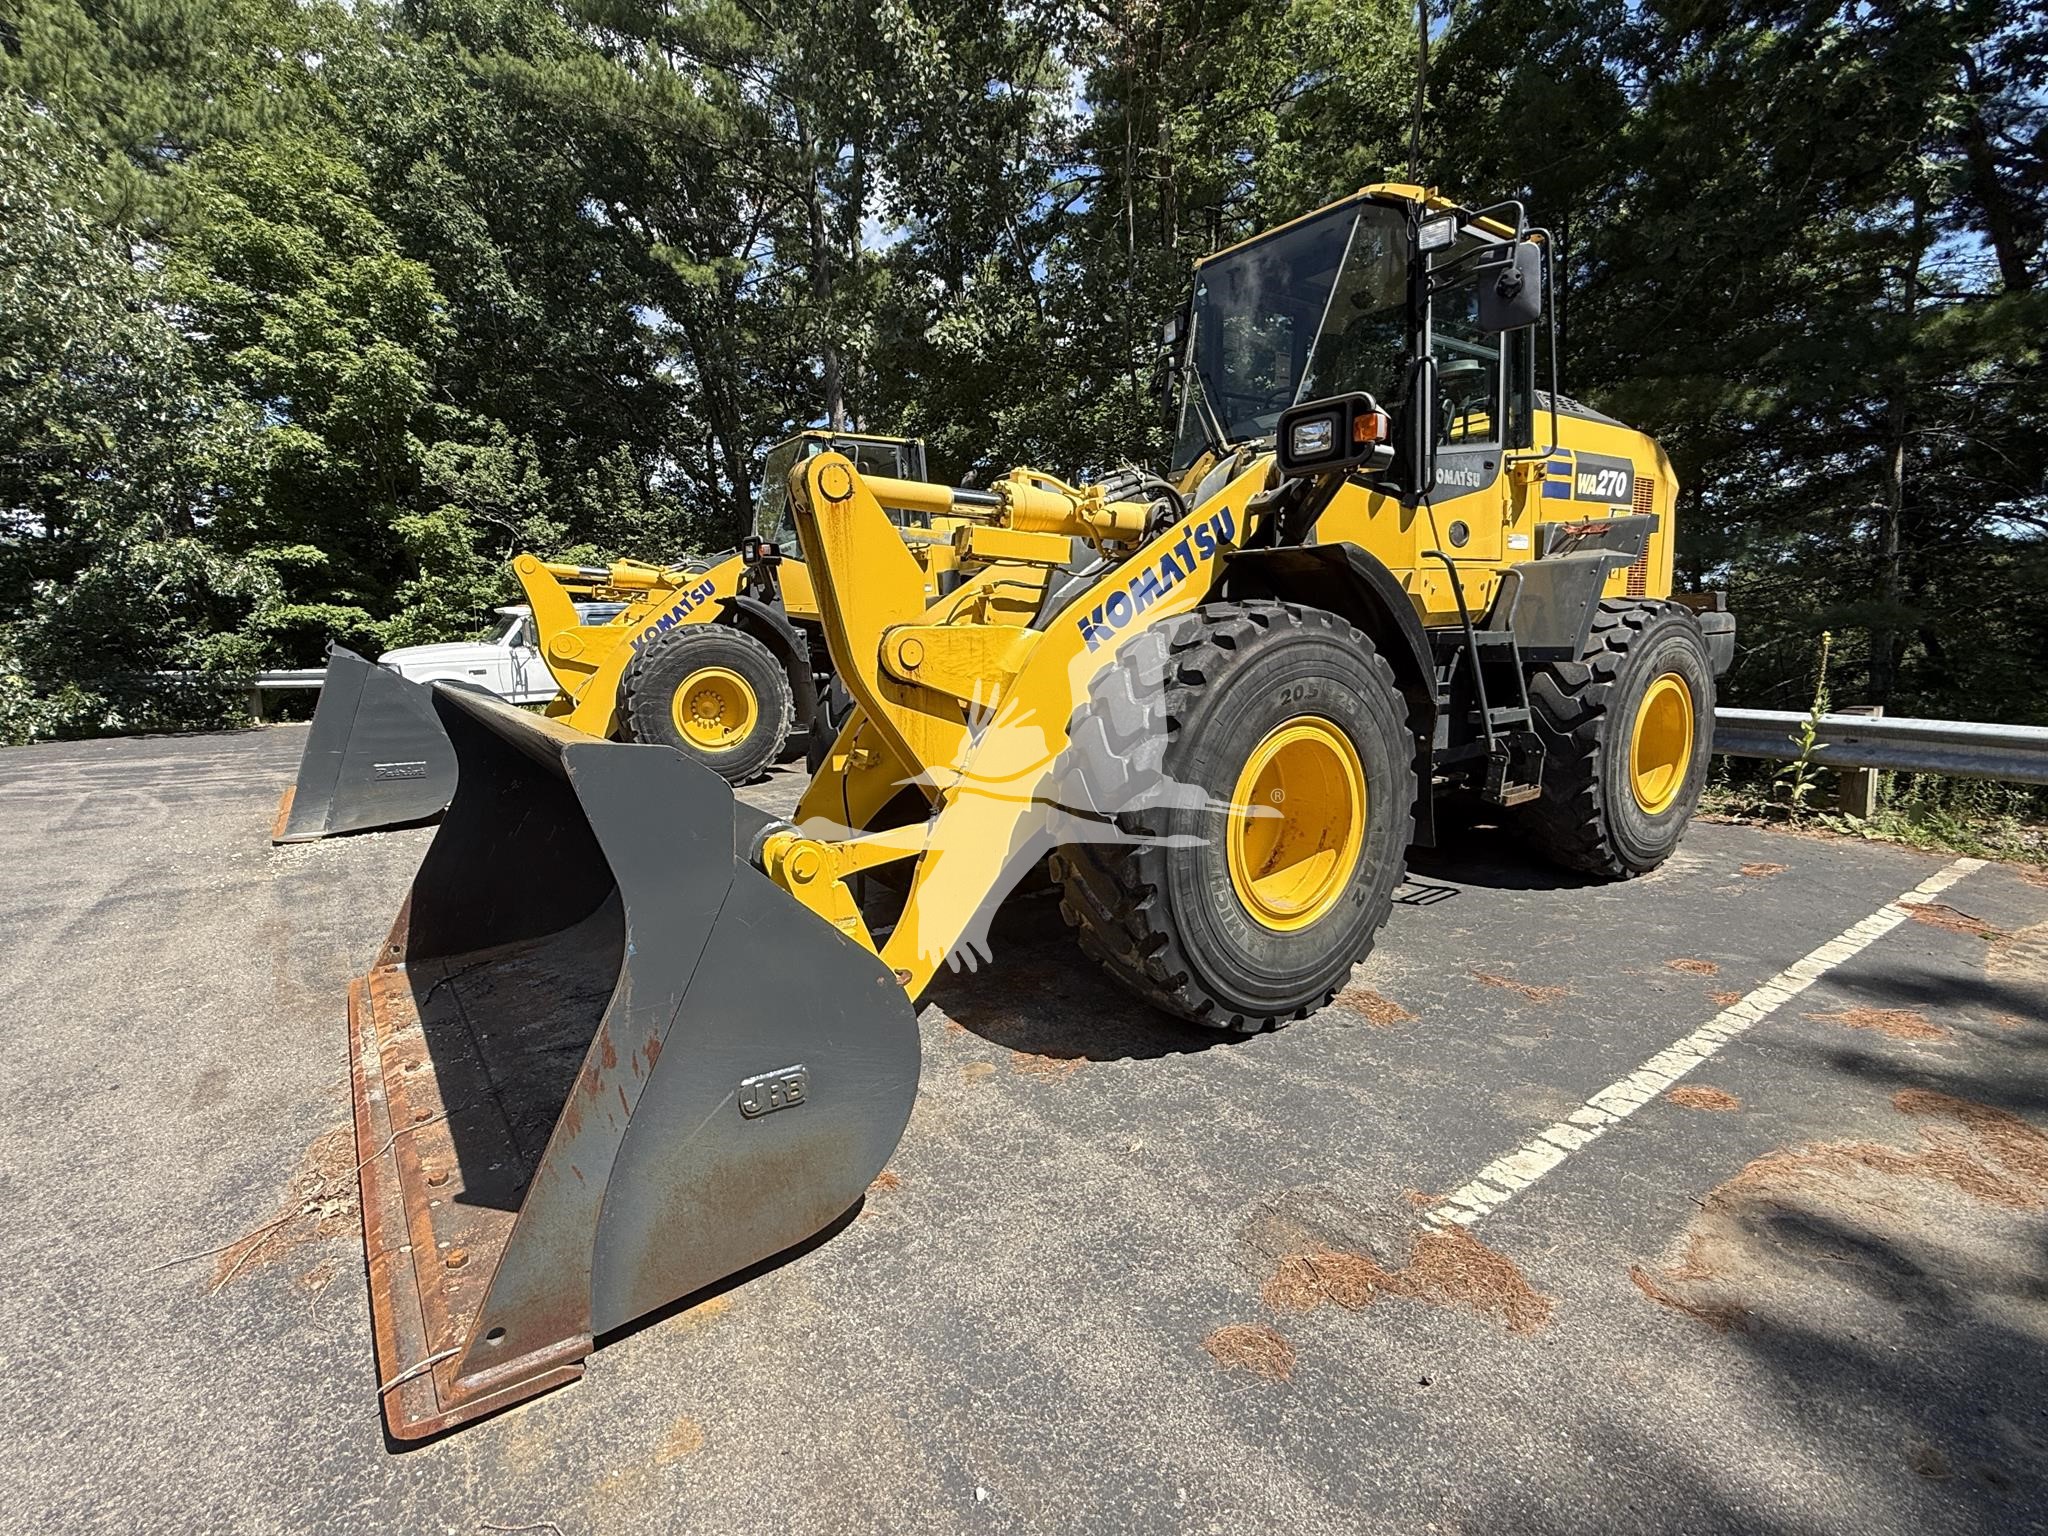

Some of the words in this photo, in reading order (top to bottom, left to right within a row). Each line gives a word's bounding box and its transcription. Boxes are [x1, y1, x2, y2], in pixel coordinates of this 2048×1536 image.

[1427, 467, 1480, 487] OMATSU
[1577, 469, 1628, 498] WA270
[1077, 506, 1236, 654] KOMATSU
[629, 579, 715, 651] KOMATSU
